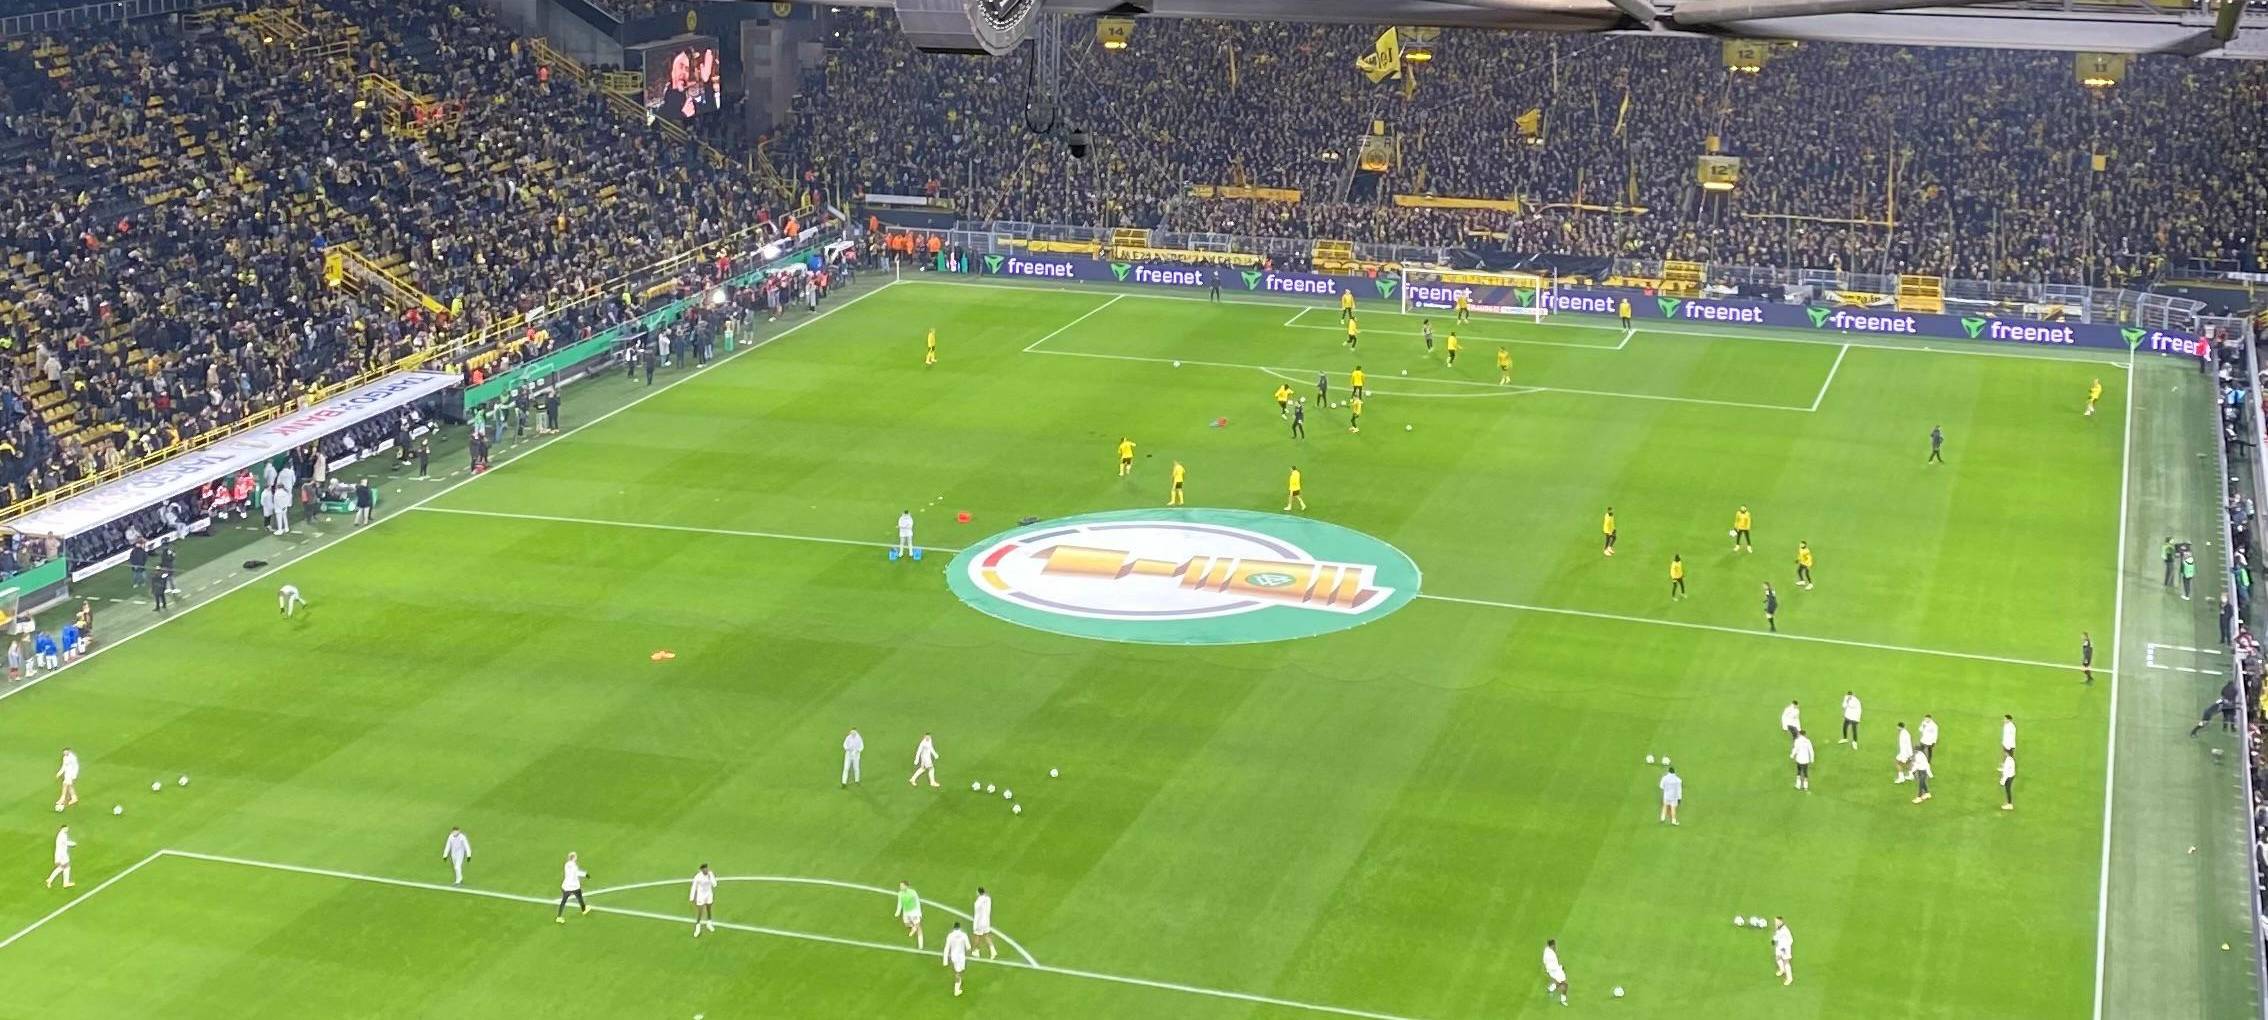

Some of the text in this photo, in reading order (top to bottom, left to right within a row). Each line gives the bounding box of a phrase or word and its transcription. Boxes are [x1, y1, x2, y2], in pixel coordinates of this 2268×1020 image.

[1738, 49, 1754, 59] 12
[1711, 165, 1728, 175] 12
[1008, 257, 1074, 277] freenet
[1135, 265, 1204, 286] freenet
[1265, 274, 1336, 294] freenet
[1541, 291, 1615, 312] freenet
[1685, 301, 1763, 322] freenet
[1835, 311, 1916, 333] freenet
[1991, 321, 2074, 343] freenet
